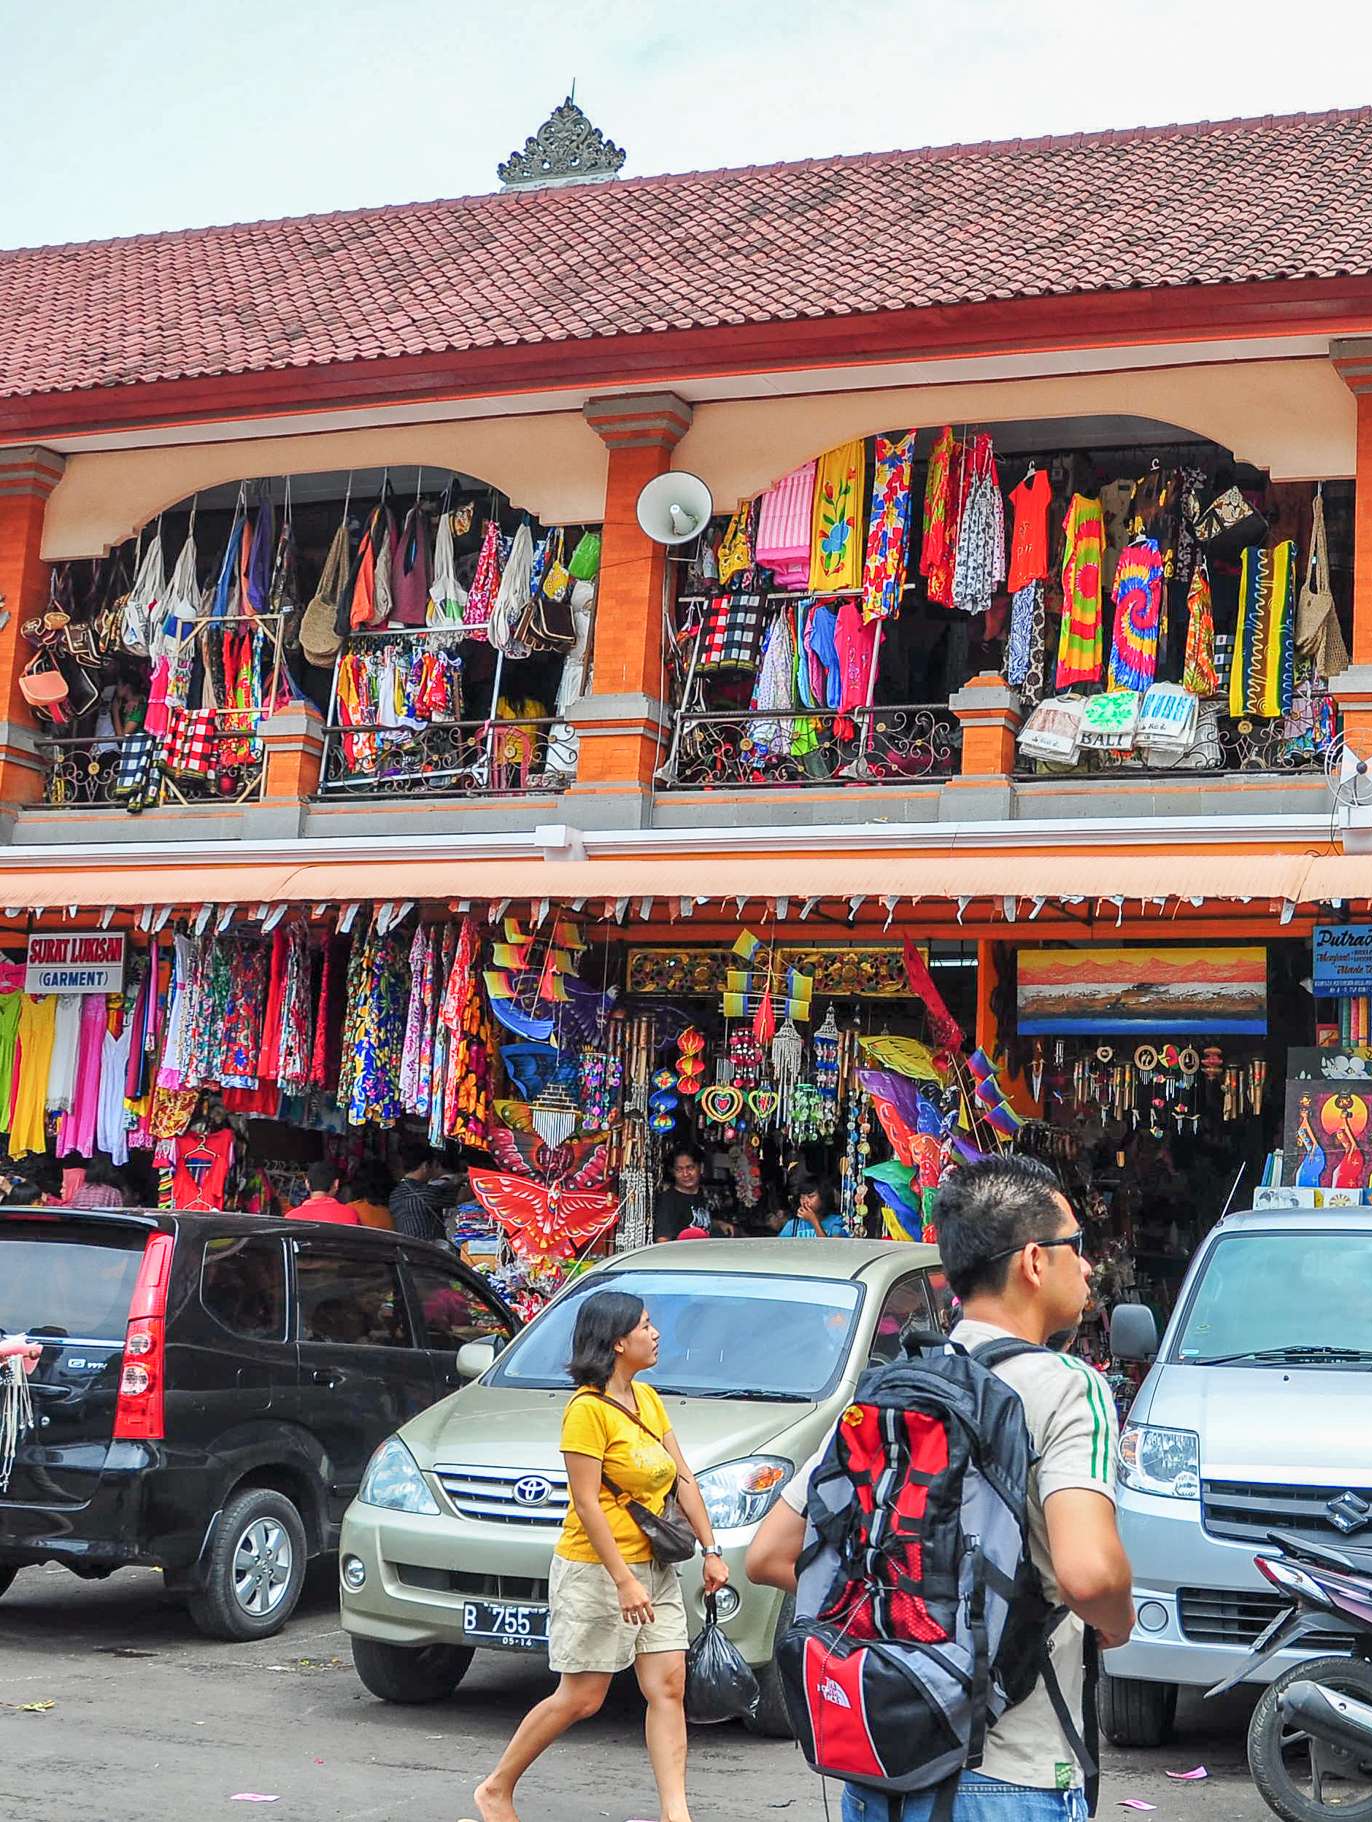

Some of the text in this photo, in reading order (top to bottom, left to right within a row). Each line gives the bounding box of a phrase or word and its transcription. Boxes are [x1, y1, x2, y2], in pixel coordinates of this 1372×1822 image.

[30, 938, 123, 963] SURAT LUKISAN
[39, 971, 109, 986] (GARMENT)
[464, 1604, 477, 1630] B
[492, 1607, 530, 1634] 755
